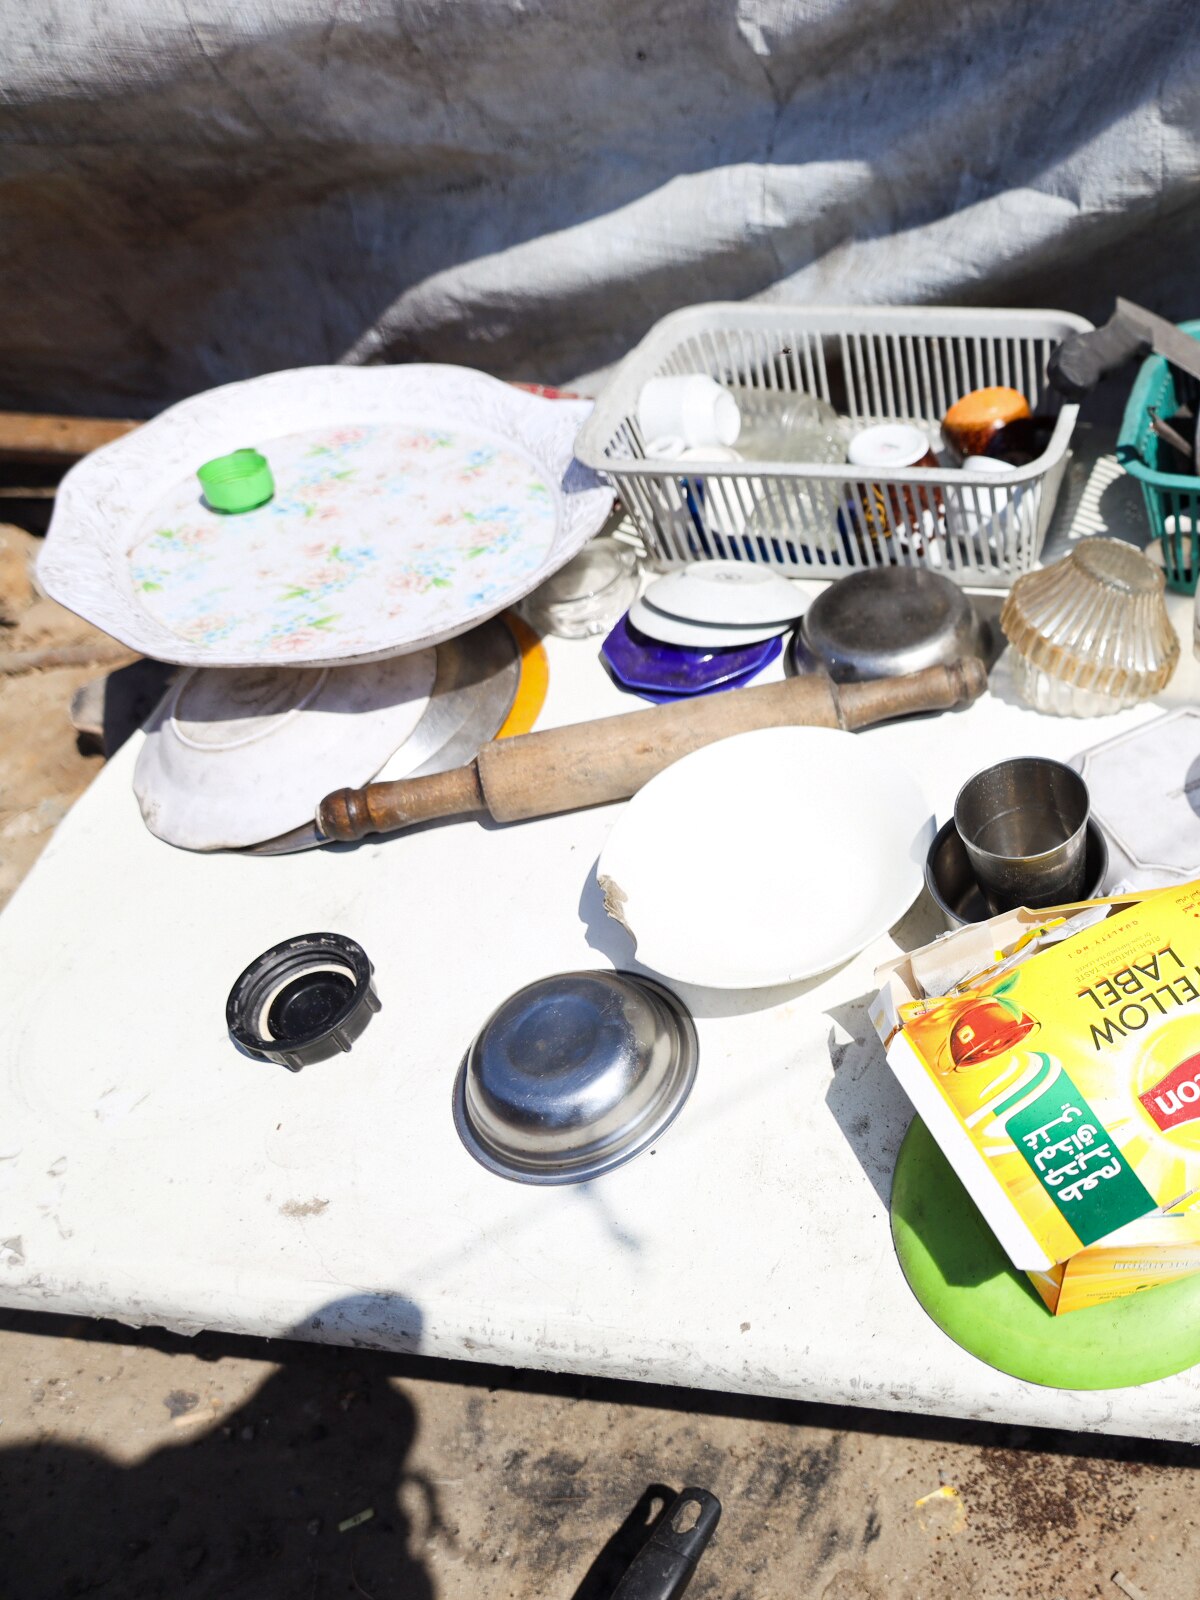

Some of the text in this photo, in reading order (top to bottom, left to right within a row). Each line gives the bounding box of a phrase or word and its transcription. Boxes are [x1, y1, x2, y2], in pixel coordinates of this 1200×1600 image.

[1095, 920, 1139, 945] QUALITY
[1075, 966, 1099, 983] TASTE
[1077, 947, 1185, 1010] LABEL
[1102, 948, 1137, 969] NATURAL
[1022, 1102, 1083, 1150] غني
[1034, 1123, 1098, 1172] لمذاق
[1043, 1143, 1111, 1186] جديد
[1057, 1156, 1122, 1202] طعم
